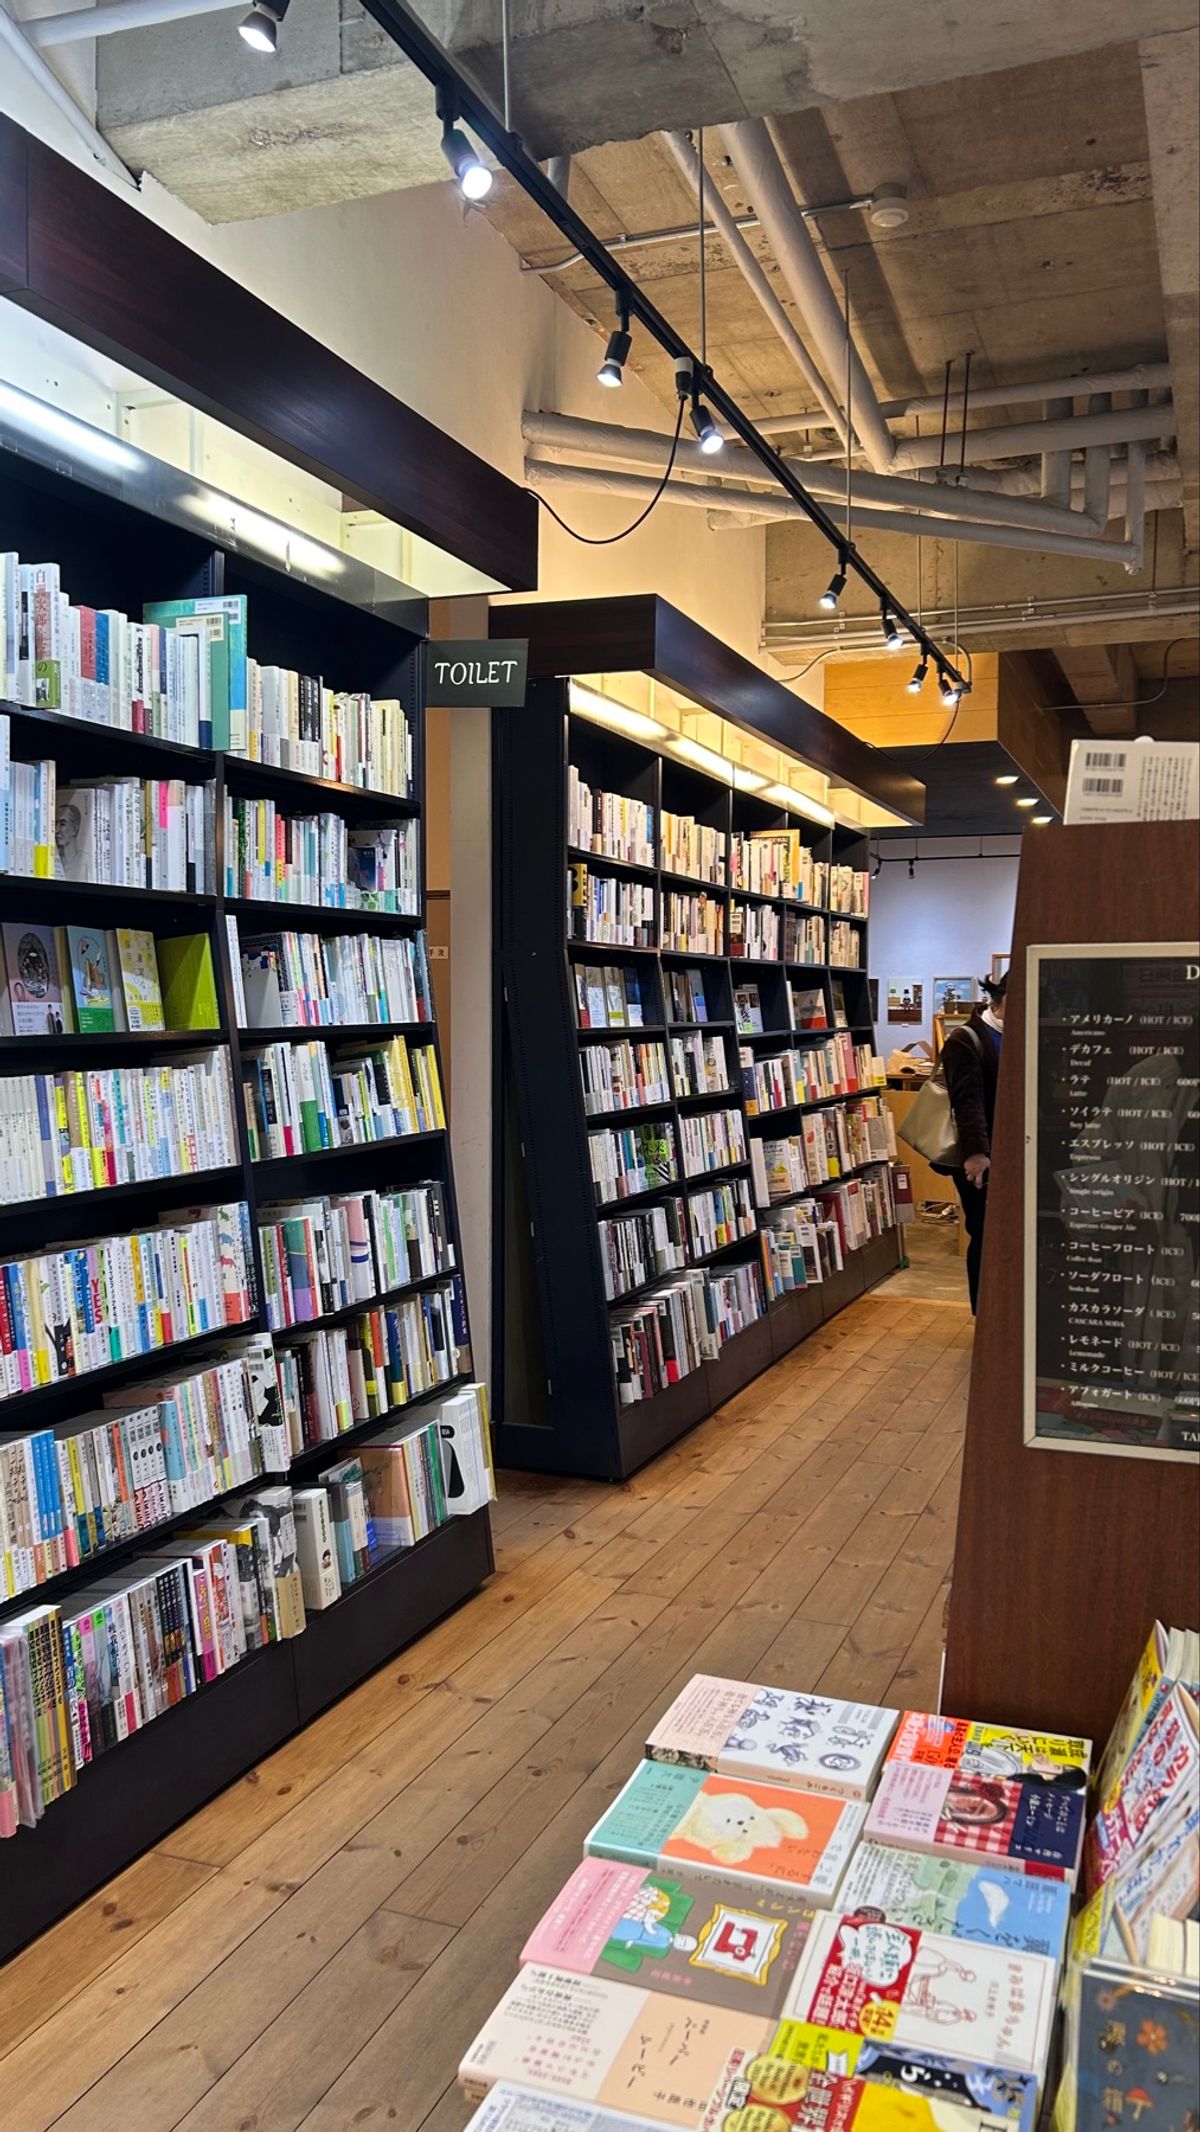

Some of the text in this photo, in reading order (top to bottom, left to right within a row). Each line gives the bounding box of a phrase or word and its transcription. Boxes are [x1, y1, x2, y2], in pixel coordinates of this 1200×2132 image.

[434, 661, 518, 685] TOILET
[1070, 1014, 1133, 1025] アメリカーノ
[1070, 1044, 1112, 1055] デカフェ
[1070, 1059, 1092, 1067] Decaf
[1070, 1075, 1091, 1084] ラテ
[1070, 1107, 1113, 1117] ソイラテ
[1069, 1139, 1134, 1149] エスプレッソ
[1069, 1173, 1155, 1185] シングルオリジン
[1070, 1208, 1134, 1218] コーヒービア
[1069, 1242, 1155, 1255] コーヒーフロート
[1069, 1271, 1144, 1284] ソーダフロート
[91, 1278, 102, 1325] YES
[1069, 1303, 1145, 1317] カスカラソーダ
[1069, 1317, 1102, 1326] CASCARA
[1070, 1335, 1122, 1347] レモネード
[1069, 1350, 1105, 1359] Lemonade
[1070, 1363, 1145, 1376] ミルクコーヒー
[1069, 1386, 1132, 1400] アフォガート
